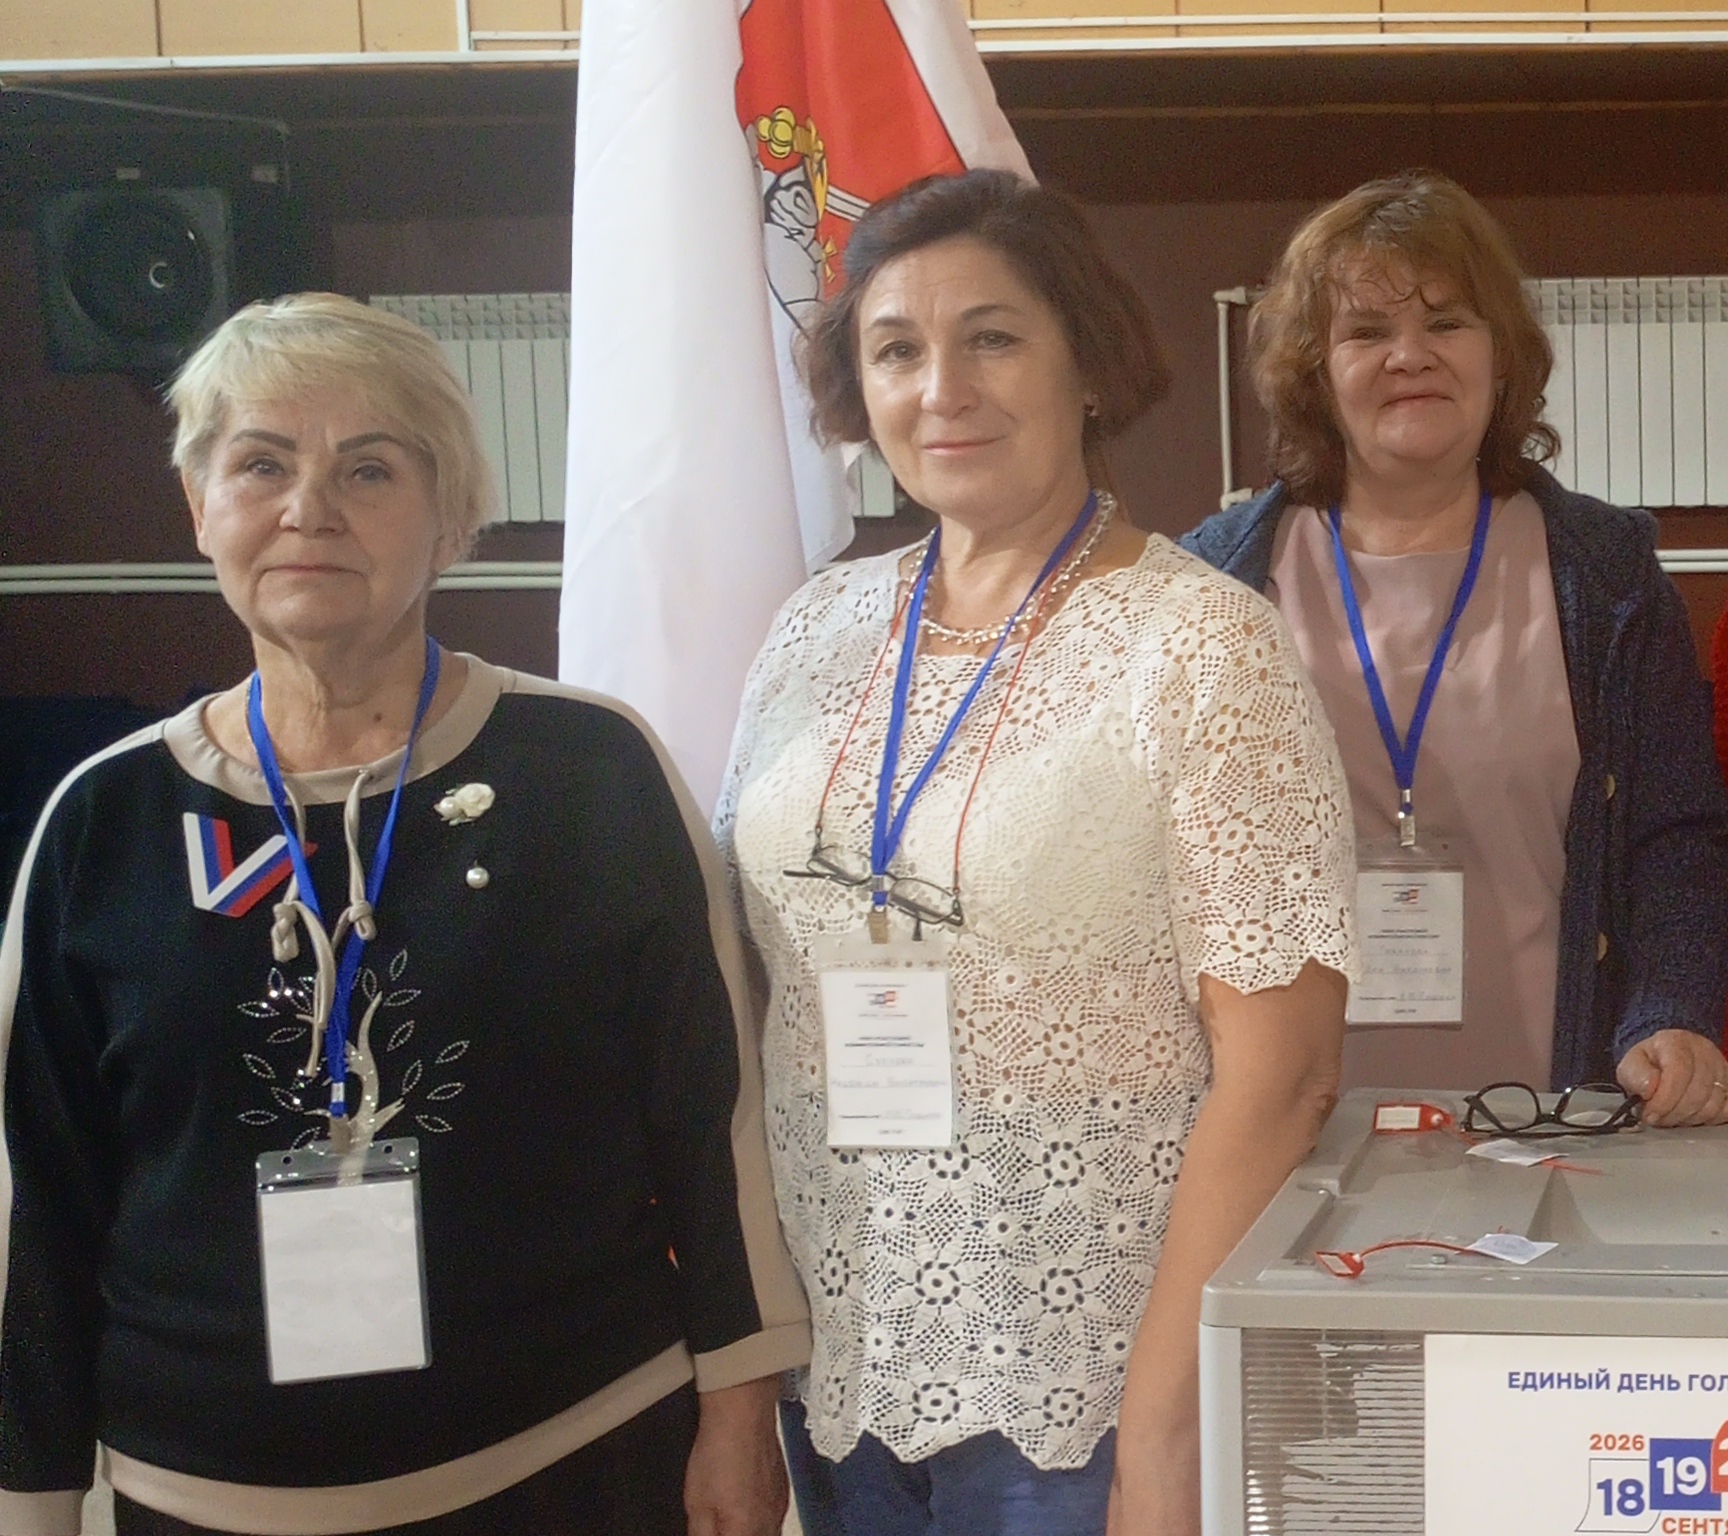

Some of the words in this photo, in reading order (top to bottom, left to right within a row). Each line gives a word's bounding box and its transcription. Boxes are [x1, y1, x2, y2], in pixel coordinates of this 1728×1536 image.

[1507, 1368, 1611, 1393] ЕДИНЫЙ
[1616, 1373, 1681, 1395] ДЕНЬ
[1588, 1433, 1645, 1452] 2026
[1596, 1478, 1646, 1517] 18
[1656, 1456, 1707, 1496] 19
